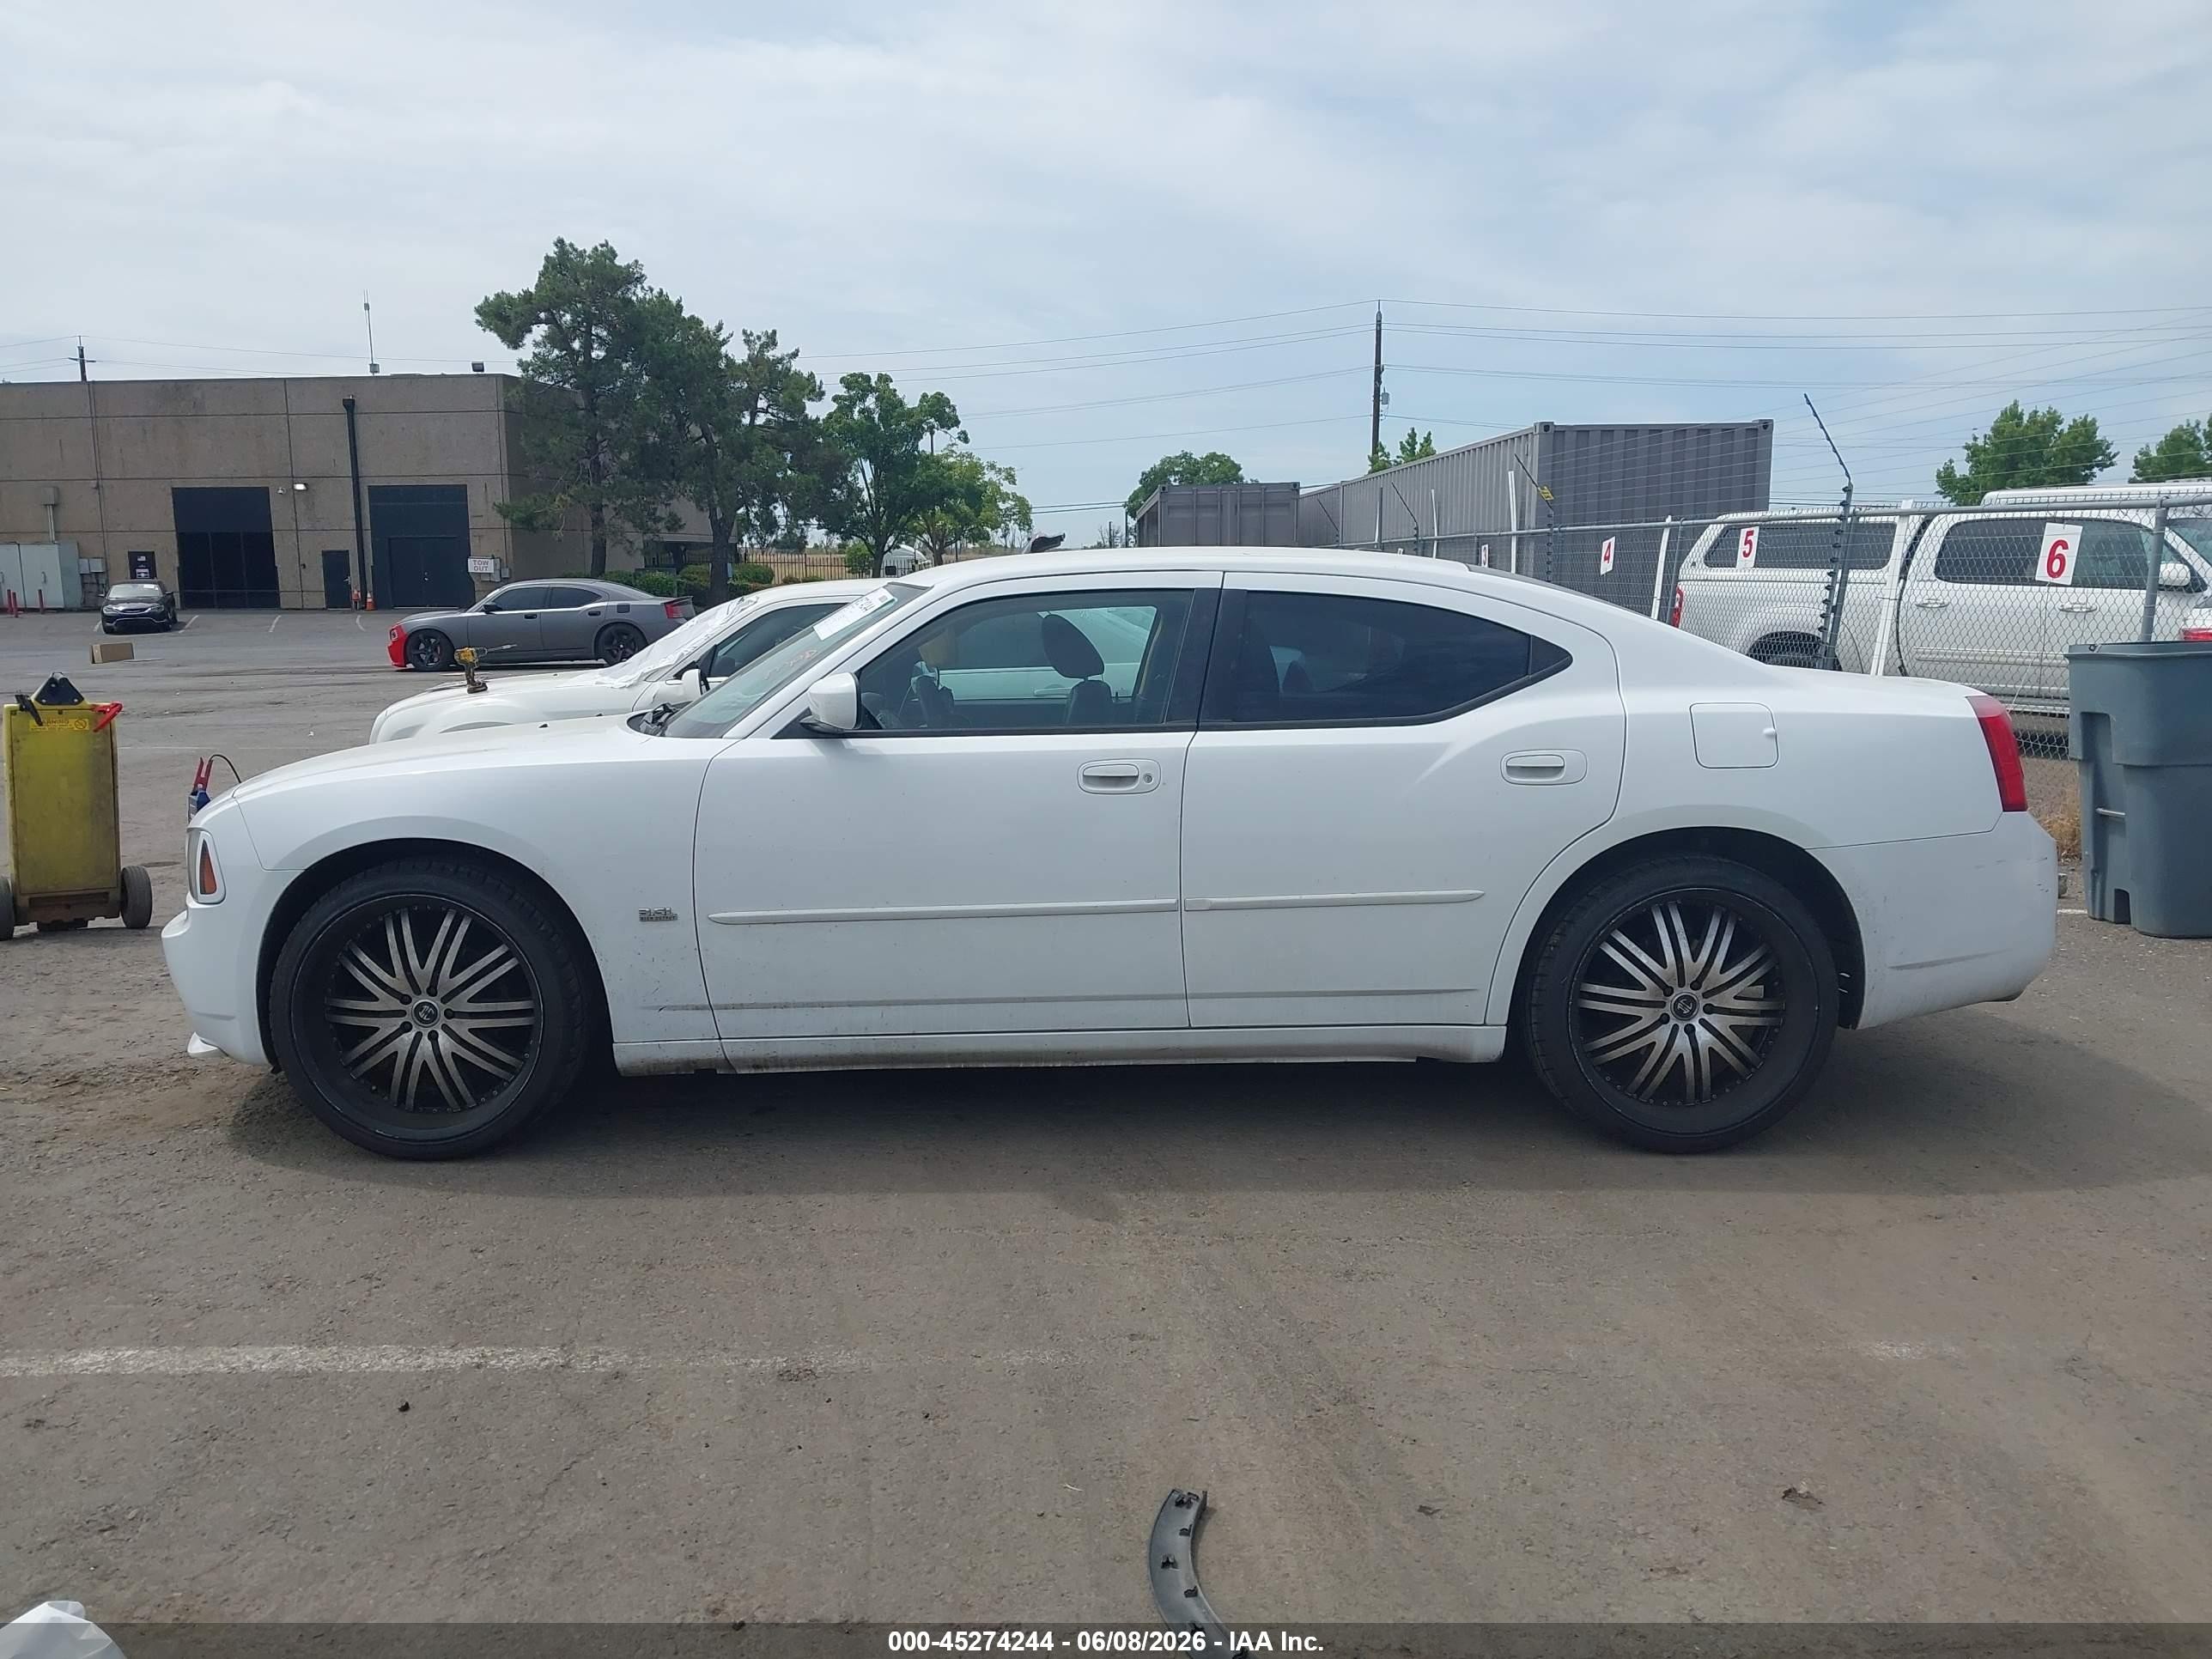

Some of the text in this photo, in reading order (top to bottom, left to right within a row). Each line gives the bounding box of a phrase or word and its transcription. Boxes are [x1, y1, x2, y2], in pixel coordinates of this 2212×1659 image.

[1482, 546, 1487, 565] 3
[1603, 542, 1612, 564] 4
[1742, 530, 1754, 558] 5
[2046, 539, 2069, 579] 6
